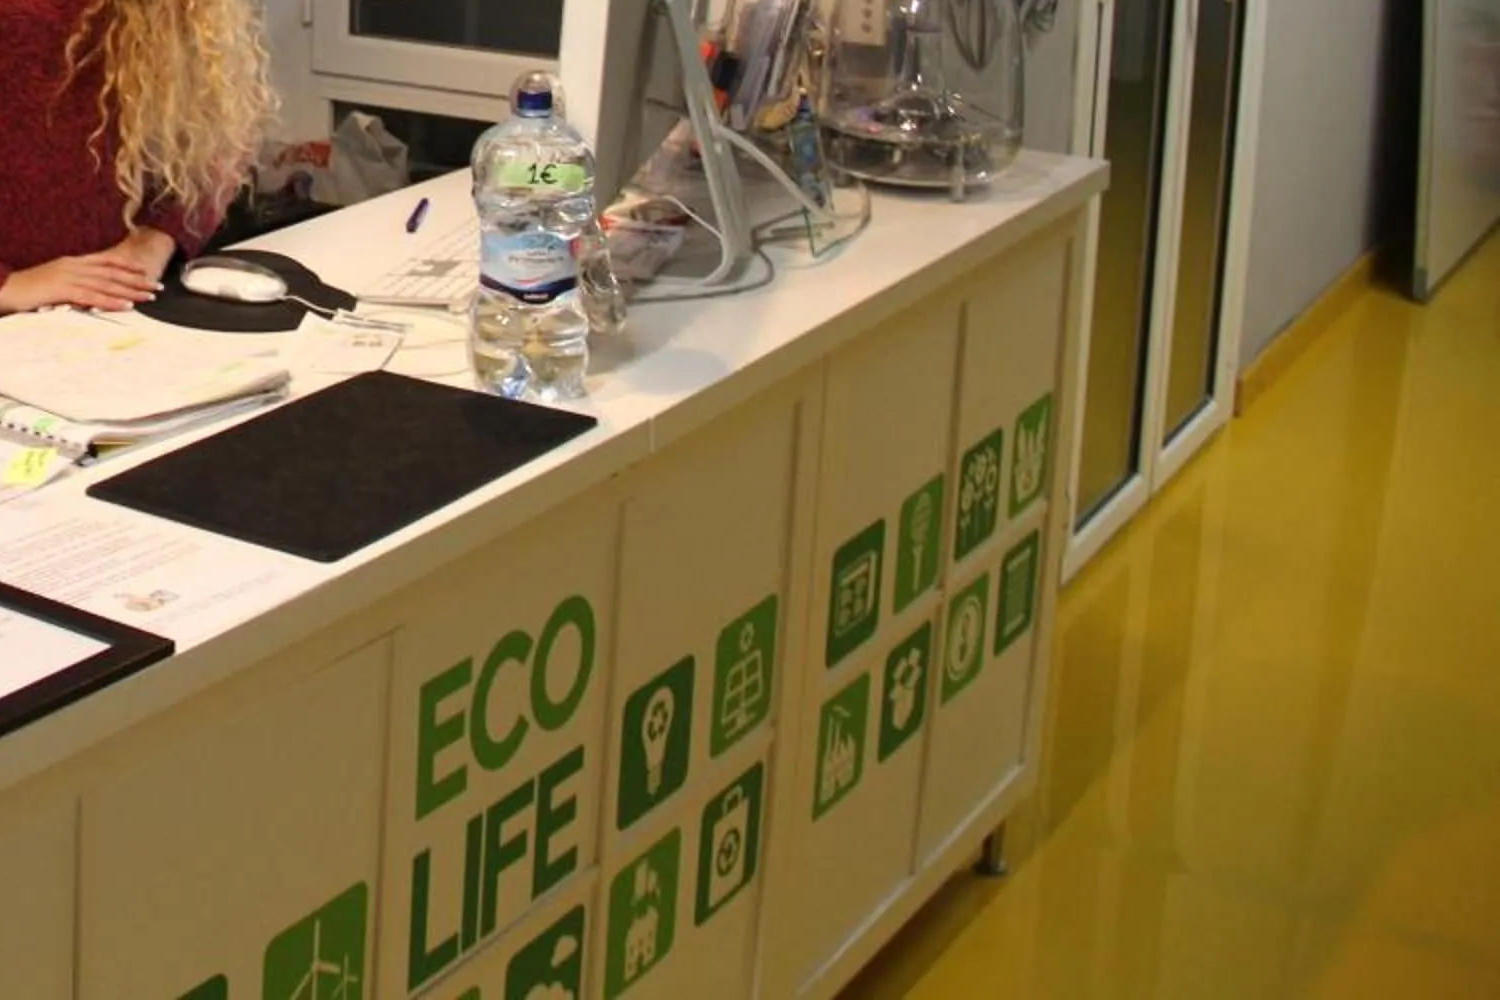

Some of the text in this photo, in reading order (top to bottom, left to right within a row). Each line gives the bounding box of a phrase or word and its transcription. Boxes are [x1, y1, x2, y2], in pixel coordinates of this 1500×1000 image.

[527, 162, 558, 185] 1€
[415, 594, 596, 823] ECO
[408, 743, 585, 997] LIFE
